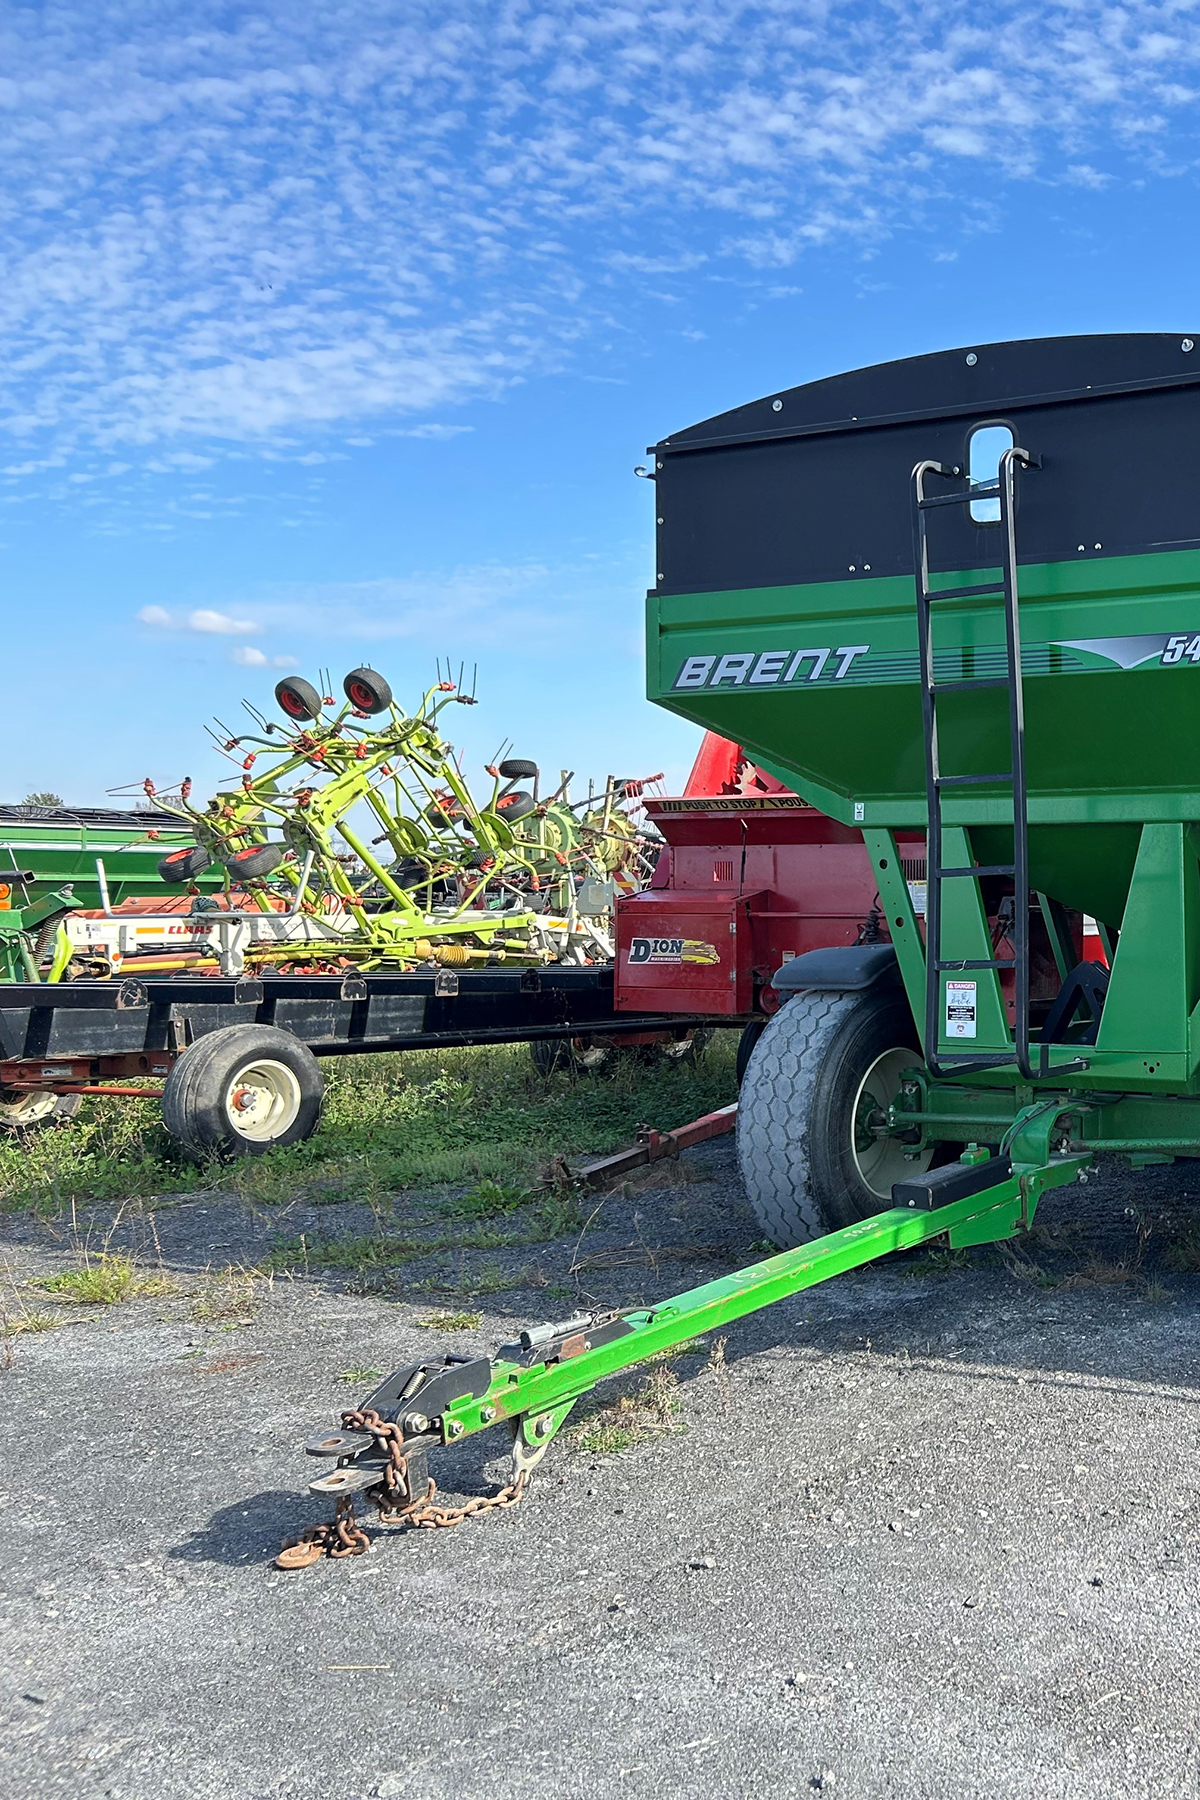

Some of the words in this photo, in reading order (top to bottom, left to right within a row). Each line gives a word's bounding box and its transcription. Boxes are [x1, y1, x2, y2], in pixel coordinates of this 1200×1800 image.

[673, 644, 870, 689] BRENT
[685, 801, 713, 811] PUSH
[714, 801, 728, 810] TO
[729, 799, 757, 809] STOP
[168, 925, 214, 934] CLAAS
[630, 939, 685, 962] DION
